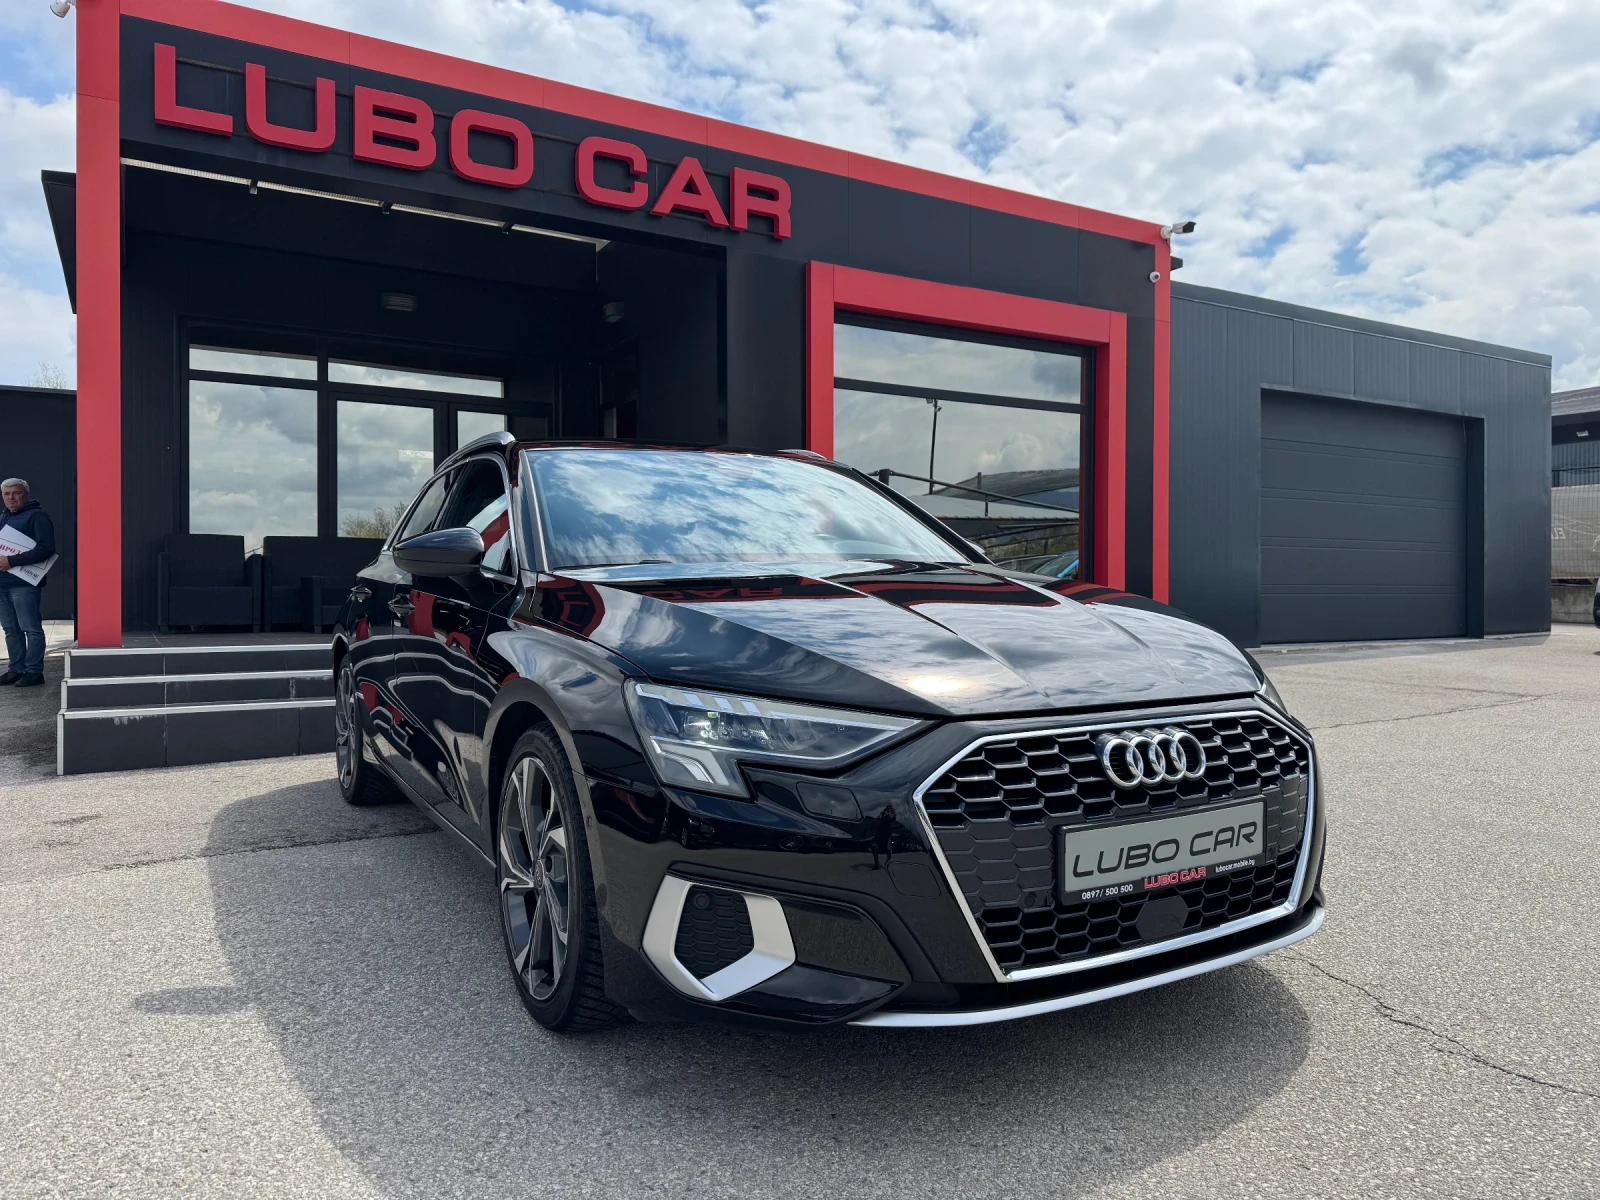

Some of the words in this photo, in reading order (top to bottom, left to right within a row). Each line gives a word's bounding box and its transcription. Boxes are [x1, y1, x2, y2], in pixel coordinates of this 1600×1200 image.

[154, 43, 534, 188] LUBO
[575, 136, 792, 239] CAR
[1072, 838, 1180, 878] LUBO
[1189, 821, 1258, 858] CAR
[1144, 872, 1179, 889] LUBO
[1180, 866, 1207, 881] CAR
[1215, 859, 1255, 873] lubocar.mobile.bg
[1105, 887, 1119, 896] 500
[1120, 884, 1134, 893] 500
